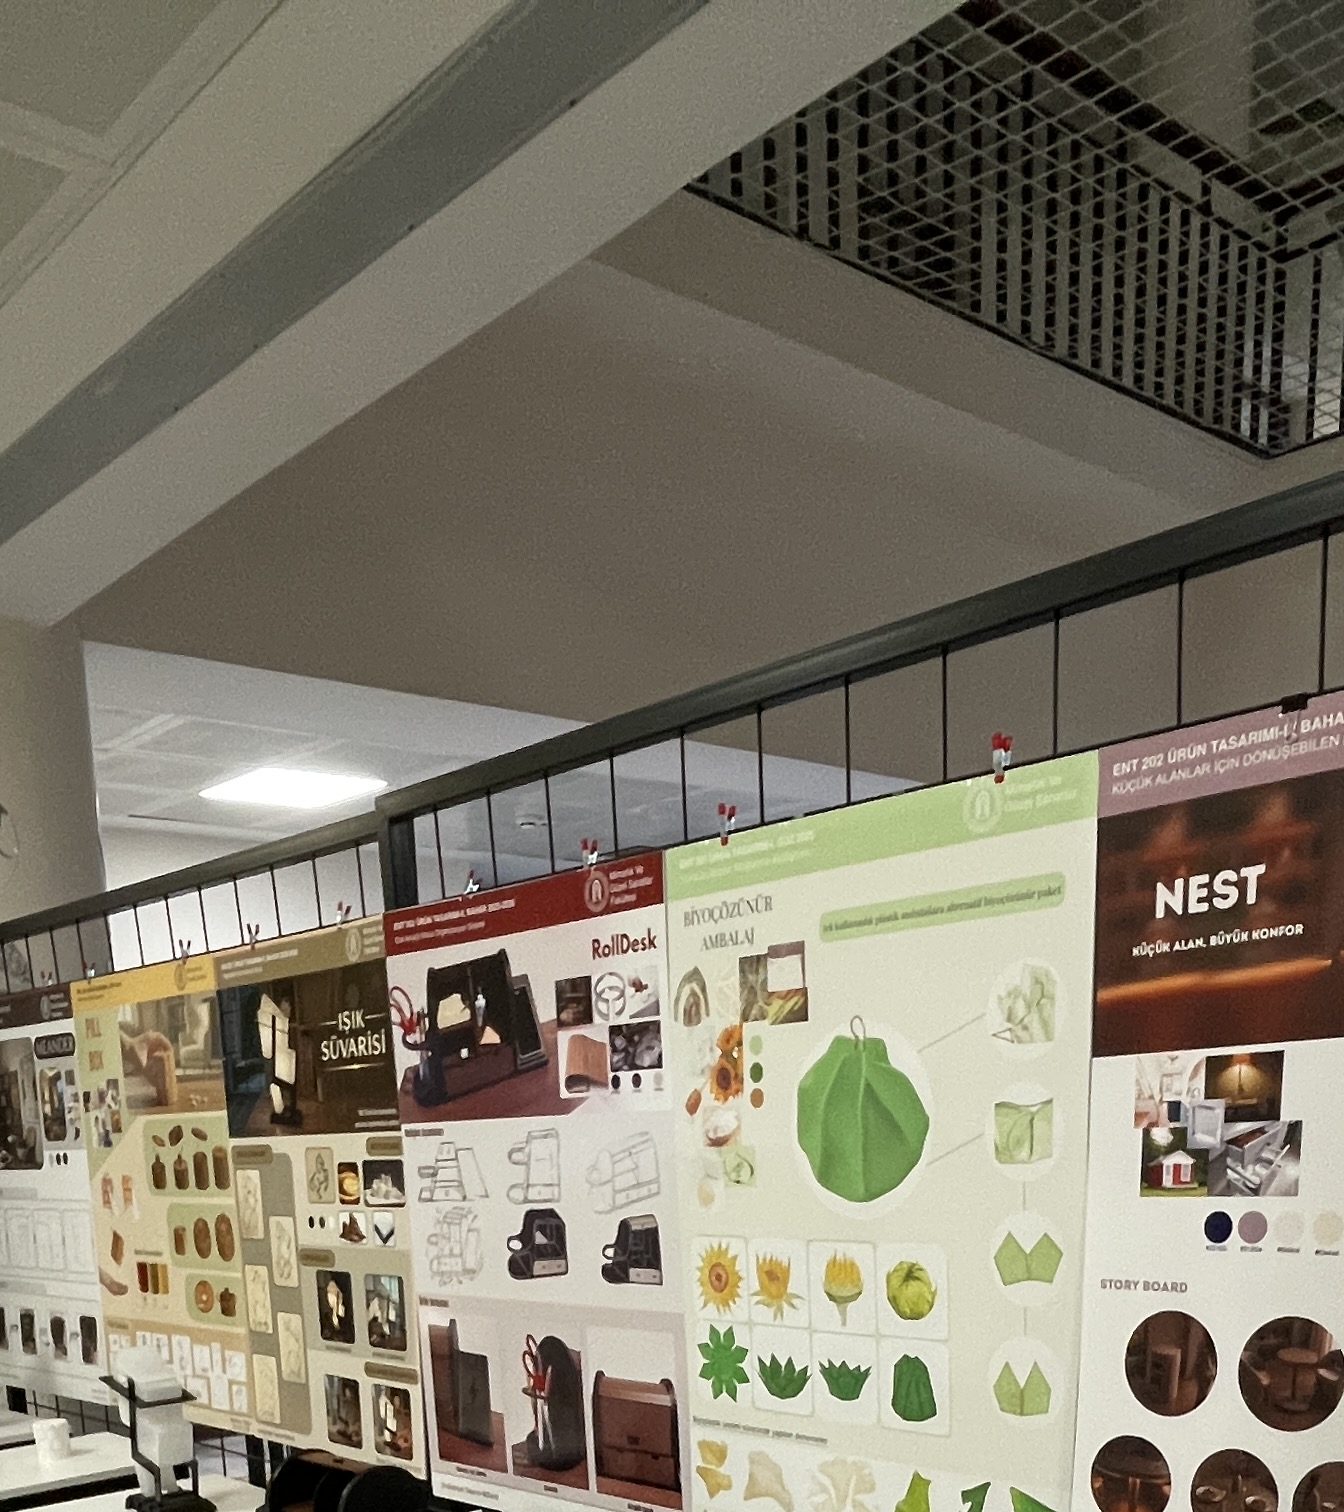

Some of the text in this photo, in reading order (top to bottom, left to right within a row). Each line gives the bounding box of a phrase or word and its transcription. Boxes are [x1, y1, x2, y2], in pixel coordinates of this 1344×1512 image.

[1112, 758, 1140, 777] ENT
[1141, 753, 1164, 771] 202
[1155, 763, 1211, 787] ALANLAR
[1155, 862, 1267, 919] NEST
[591, 927, 658, 960] RollDesk
[1132, 939, 1171, 958] KÜÇÜK
[1209, 928, 1249, 947] BÜYÜK
[1251, 923, 1305, 942] KONFOR
[338, 1008, 365, 1035] IŞIK
[320, 1028, 386, 1061] SÜVARİSİ
[1100, 1278, 1189, 1294] STORY BOARD
